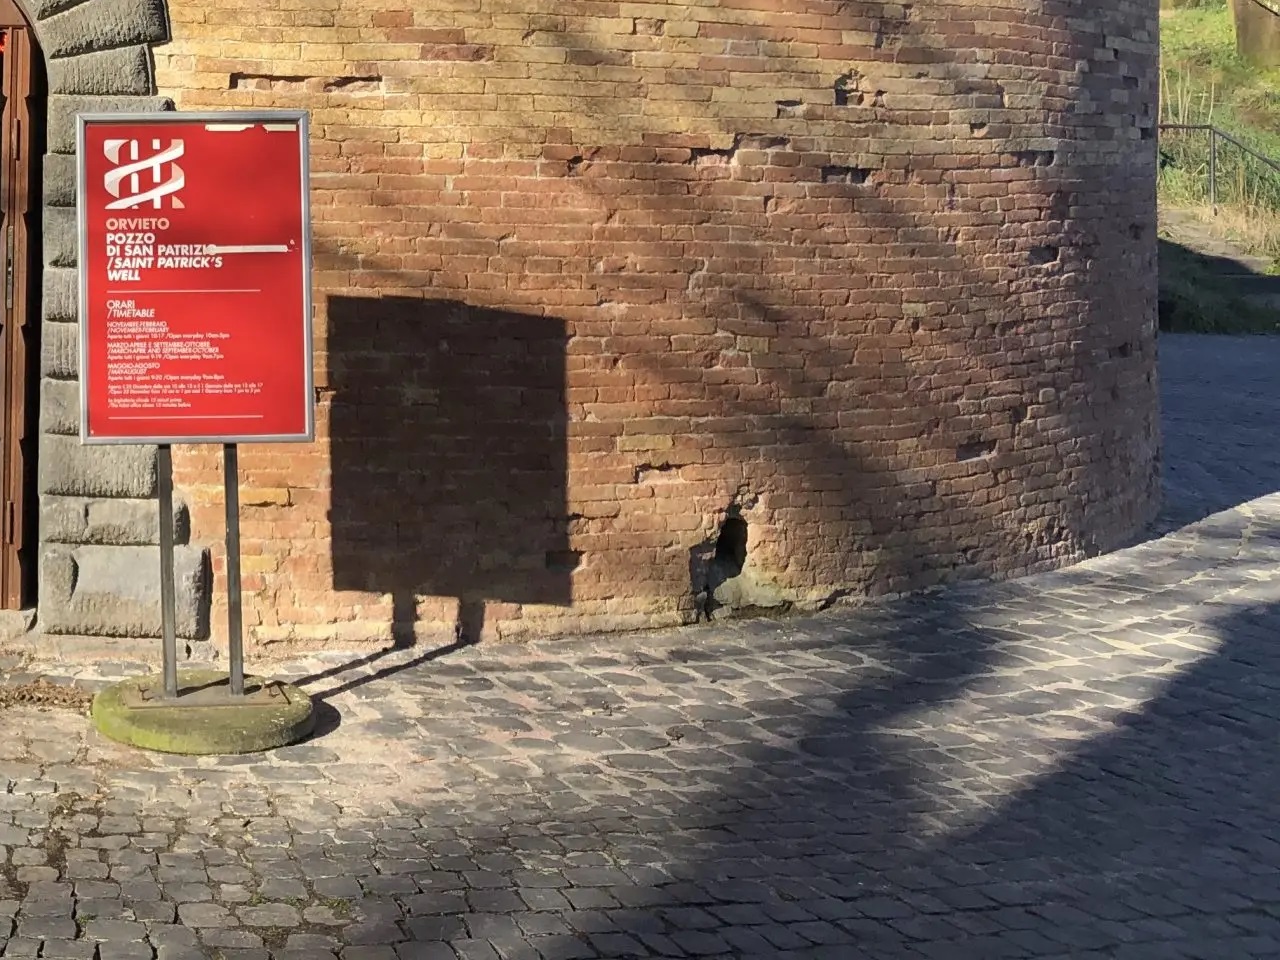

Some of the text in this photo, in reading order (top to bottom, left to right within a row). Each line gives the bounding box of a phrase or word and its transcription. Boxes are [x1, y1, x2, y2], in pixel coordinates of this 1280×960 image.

[106, 217, 170, 231] ORVIETO
[106, 232, 156, 245] POZZO
[106, 245, 120, 257] DI
[124, 245, 154, 257] SAN
[157, 256, 223, 269] PATRICK'S
[107, 269, 141, 281] WELL
[106, 299, 136, 309] ORARI
